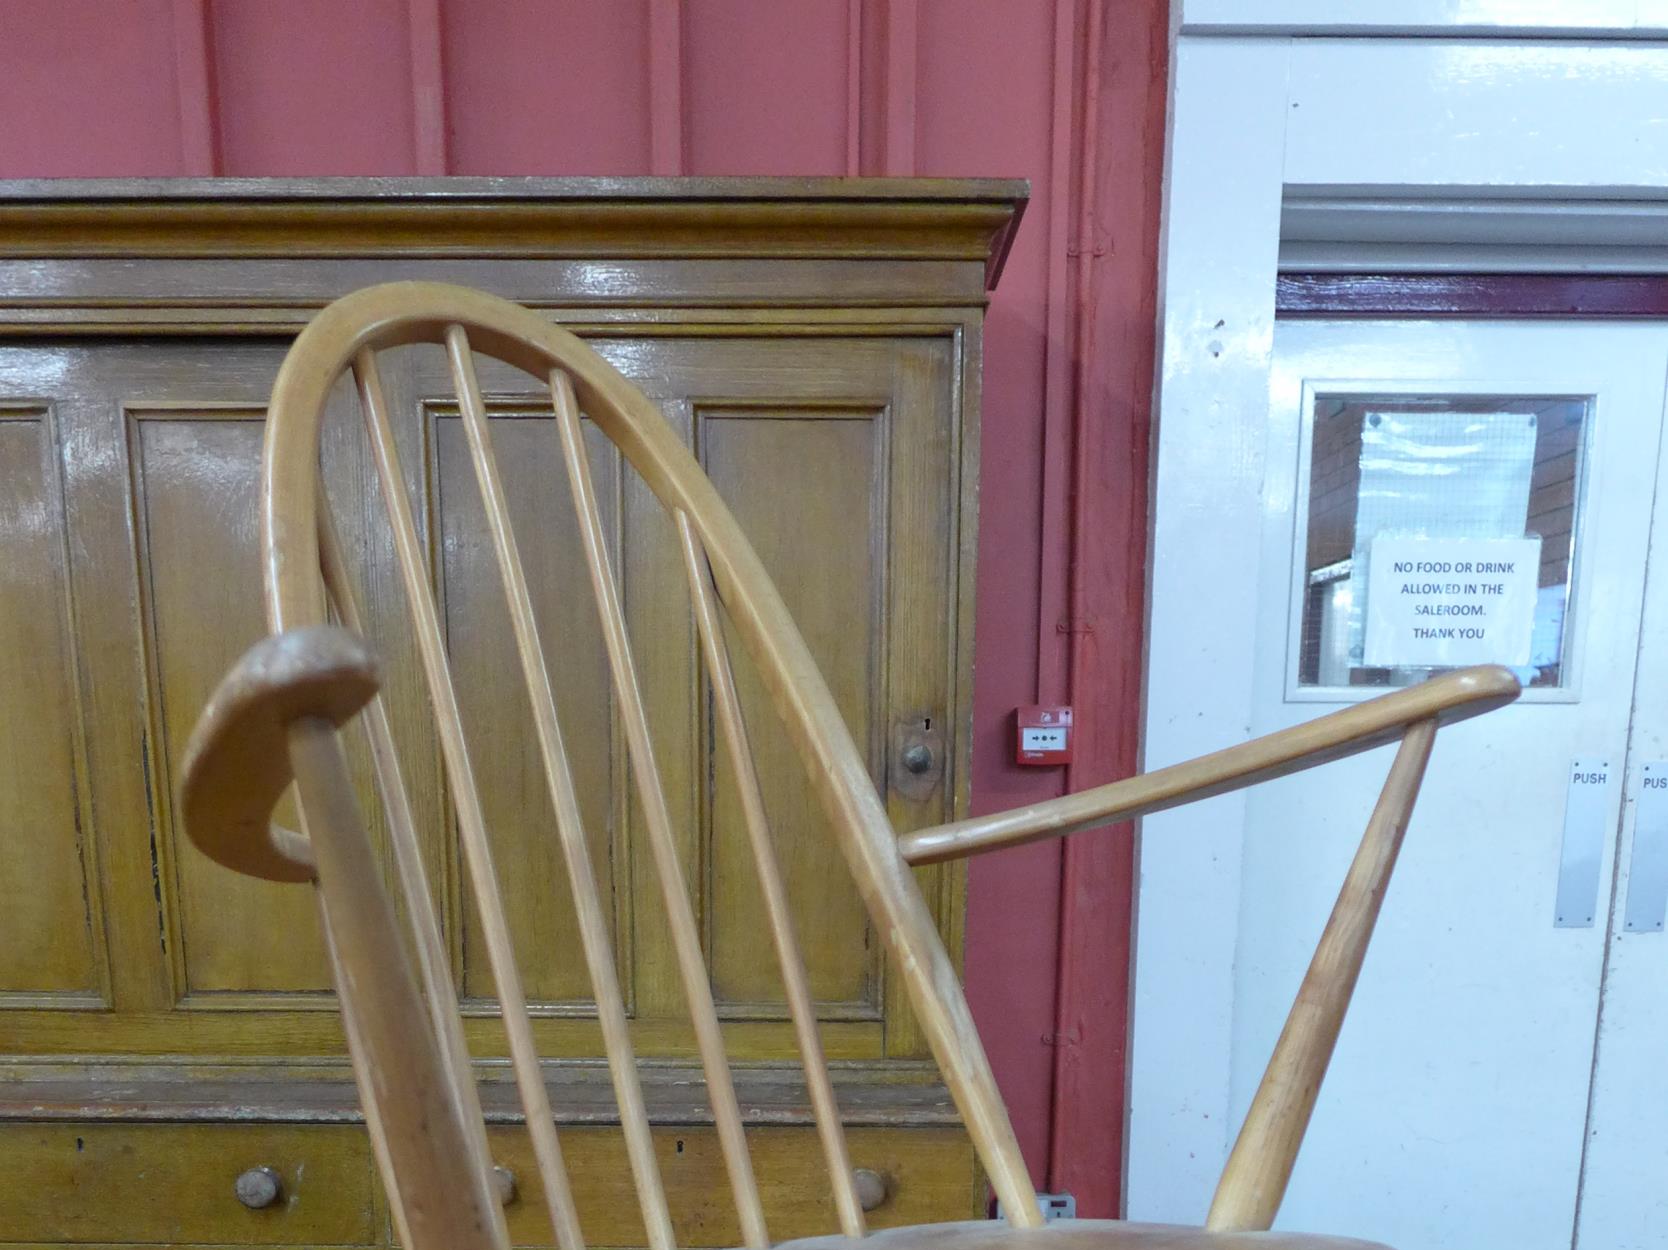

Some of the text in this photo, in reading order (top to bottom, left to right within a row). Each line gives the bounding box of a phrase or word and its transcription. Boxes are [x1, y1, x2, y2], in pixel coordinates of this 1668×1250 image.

[1393, 562, 1515, 573] NO FOOD OR DRINK
[1400, 583, 1504, 595] ALLOWED IN THE
[1414, 604, 1487, 616] SALEROOM.
[1413, 628, 1485, 639] THANK YOU
[1573, 773, 1607, 784] PUSH
[1643, 777, 1668, 789] PUS
